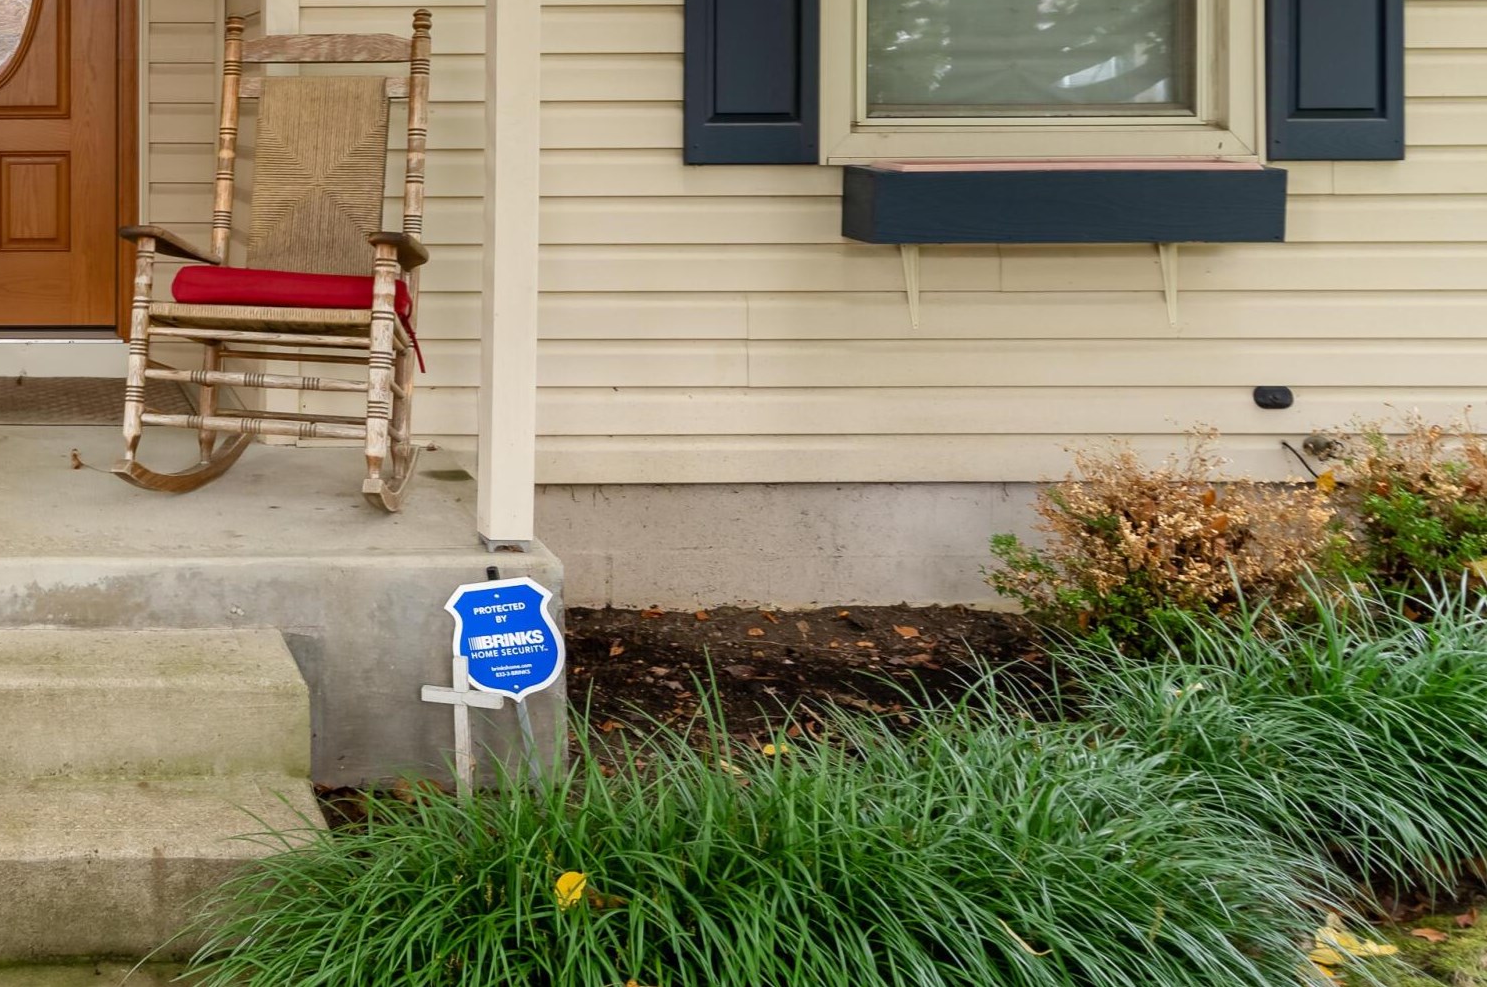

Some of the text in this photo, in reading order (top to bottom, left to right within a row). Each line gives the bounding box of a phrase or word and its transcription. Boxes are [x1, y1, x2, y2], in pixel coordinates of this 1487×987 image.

[473, 602, 526, 615] PROTECTED
[495, 615, 507, 623] BY
[479, 629, 544, 650] BRINKS
[471, 649, 499, 659] HOME
